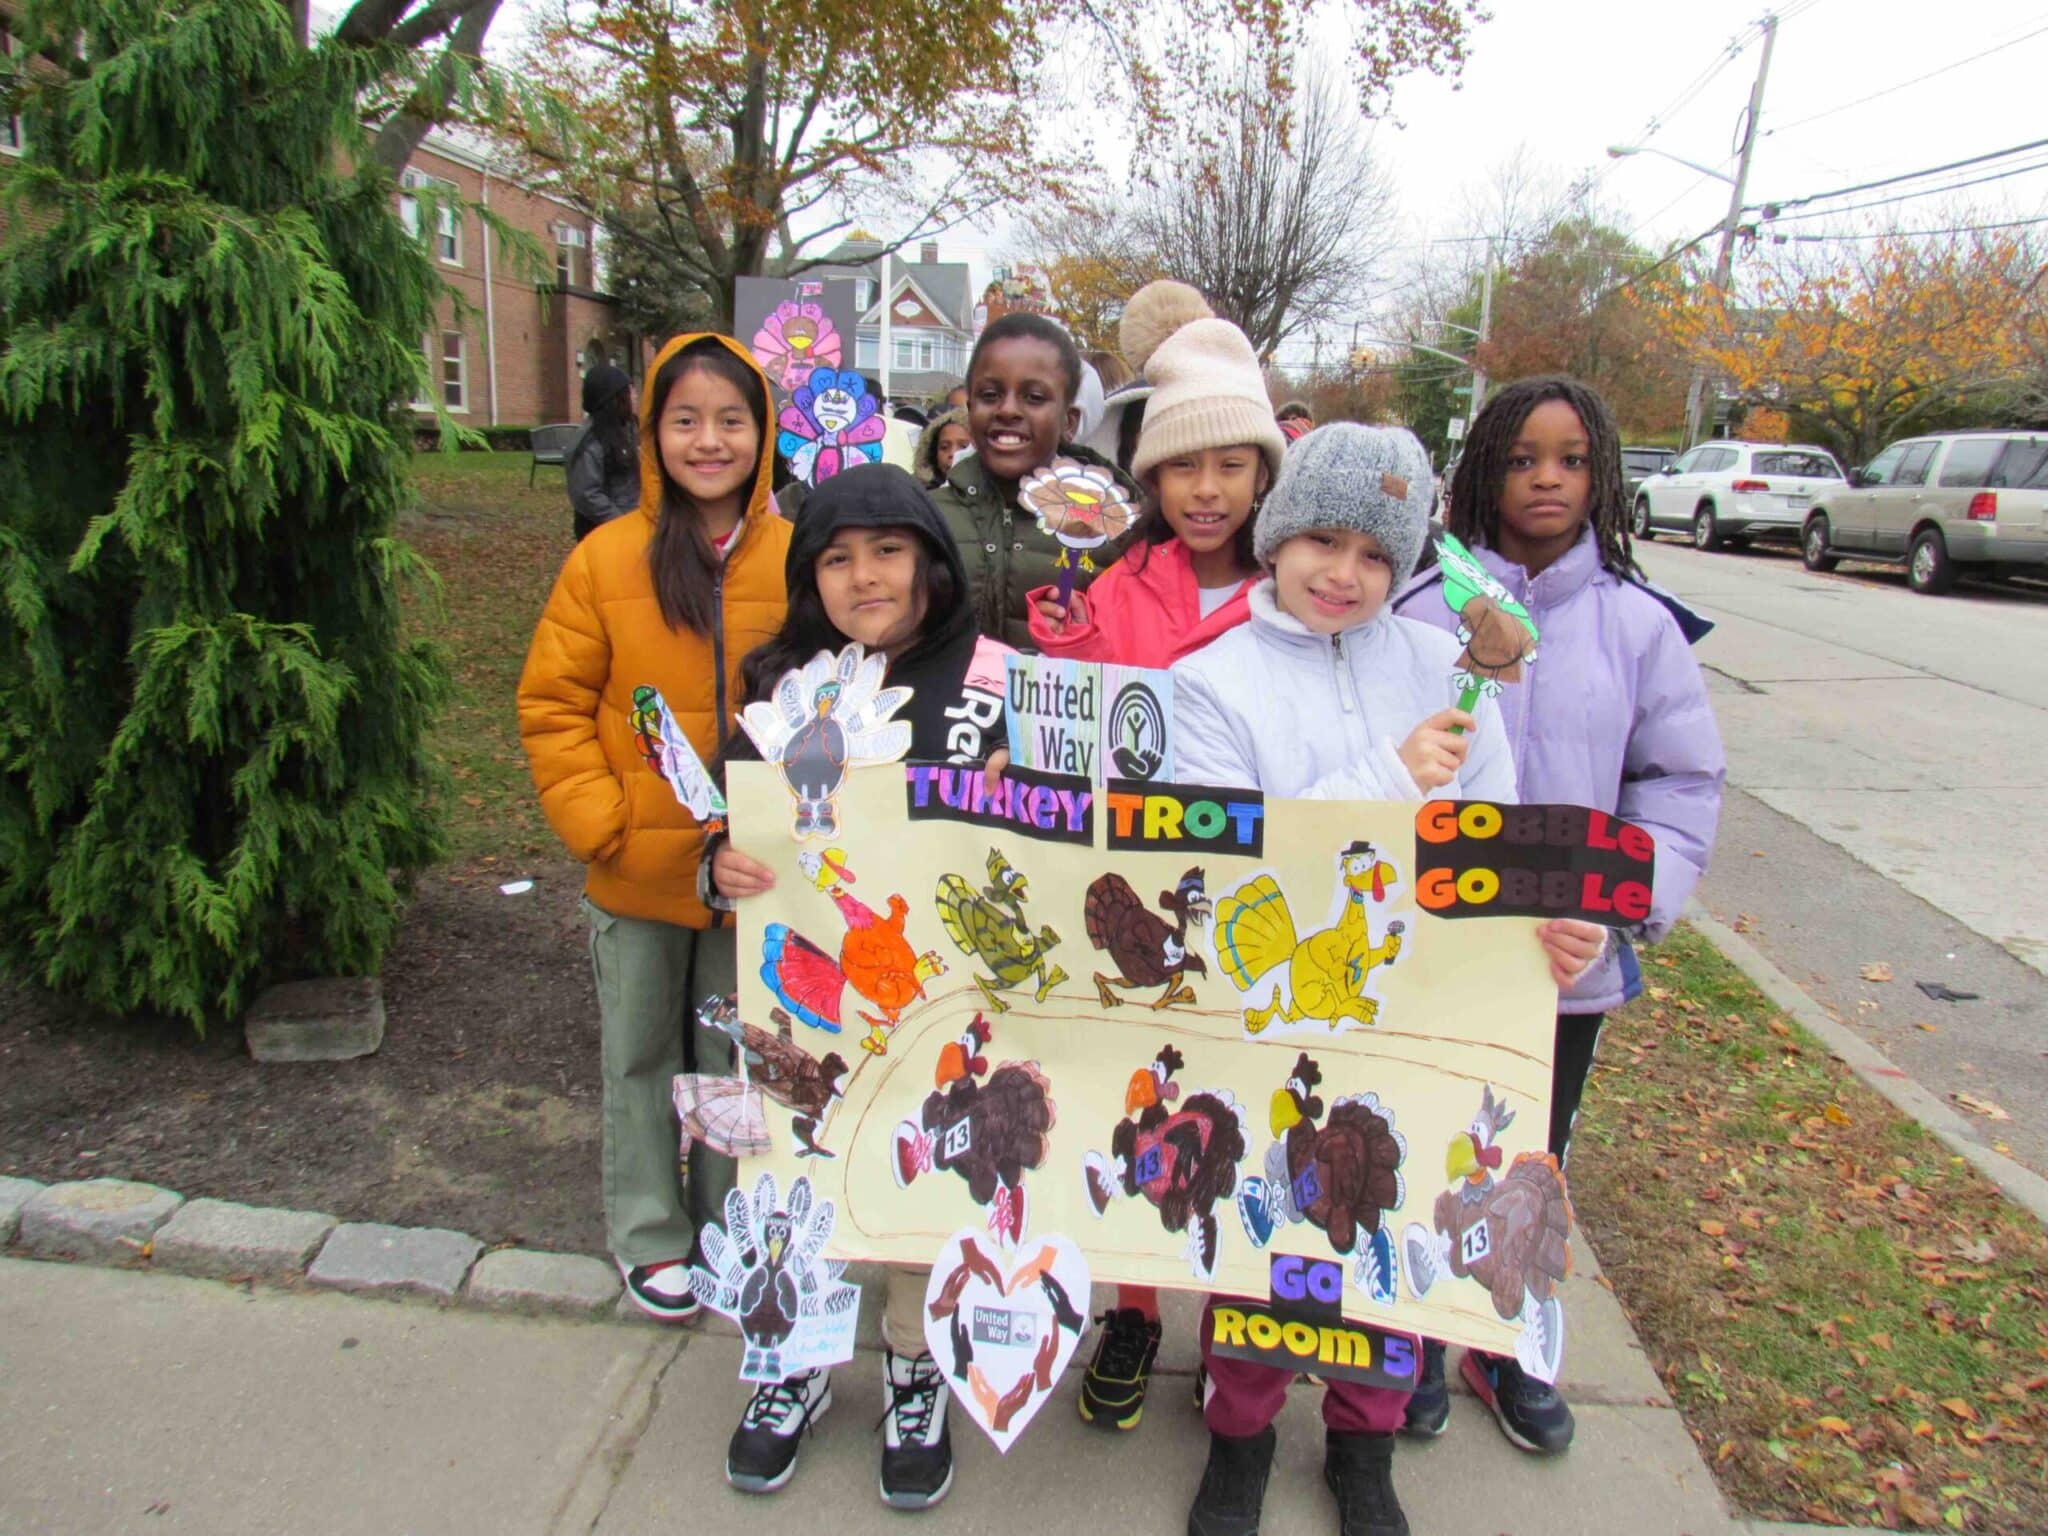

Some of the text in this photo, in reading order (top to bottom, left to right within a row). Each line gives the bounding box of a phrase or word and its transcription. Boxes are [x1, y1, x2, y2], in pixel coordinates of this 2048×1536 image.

[1008, 668, 1095, 722] United
[1040, 725, 1094, 777] Way
[1107, 793, 1264, 844] TROT
[947, 1123, 969, 1153] 13
[1137, 1150, 1160, 1179] 13
[1464, 1225, 1487, 1258] 13
[1270, 1255, 1342, 1304] GO
[975, 1309, 1009, 1328] United
[988, 1324, 1008, 1344] Way
[1383, 1336, 1414, 1378] 5
